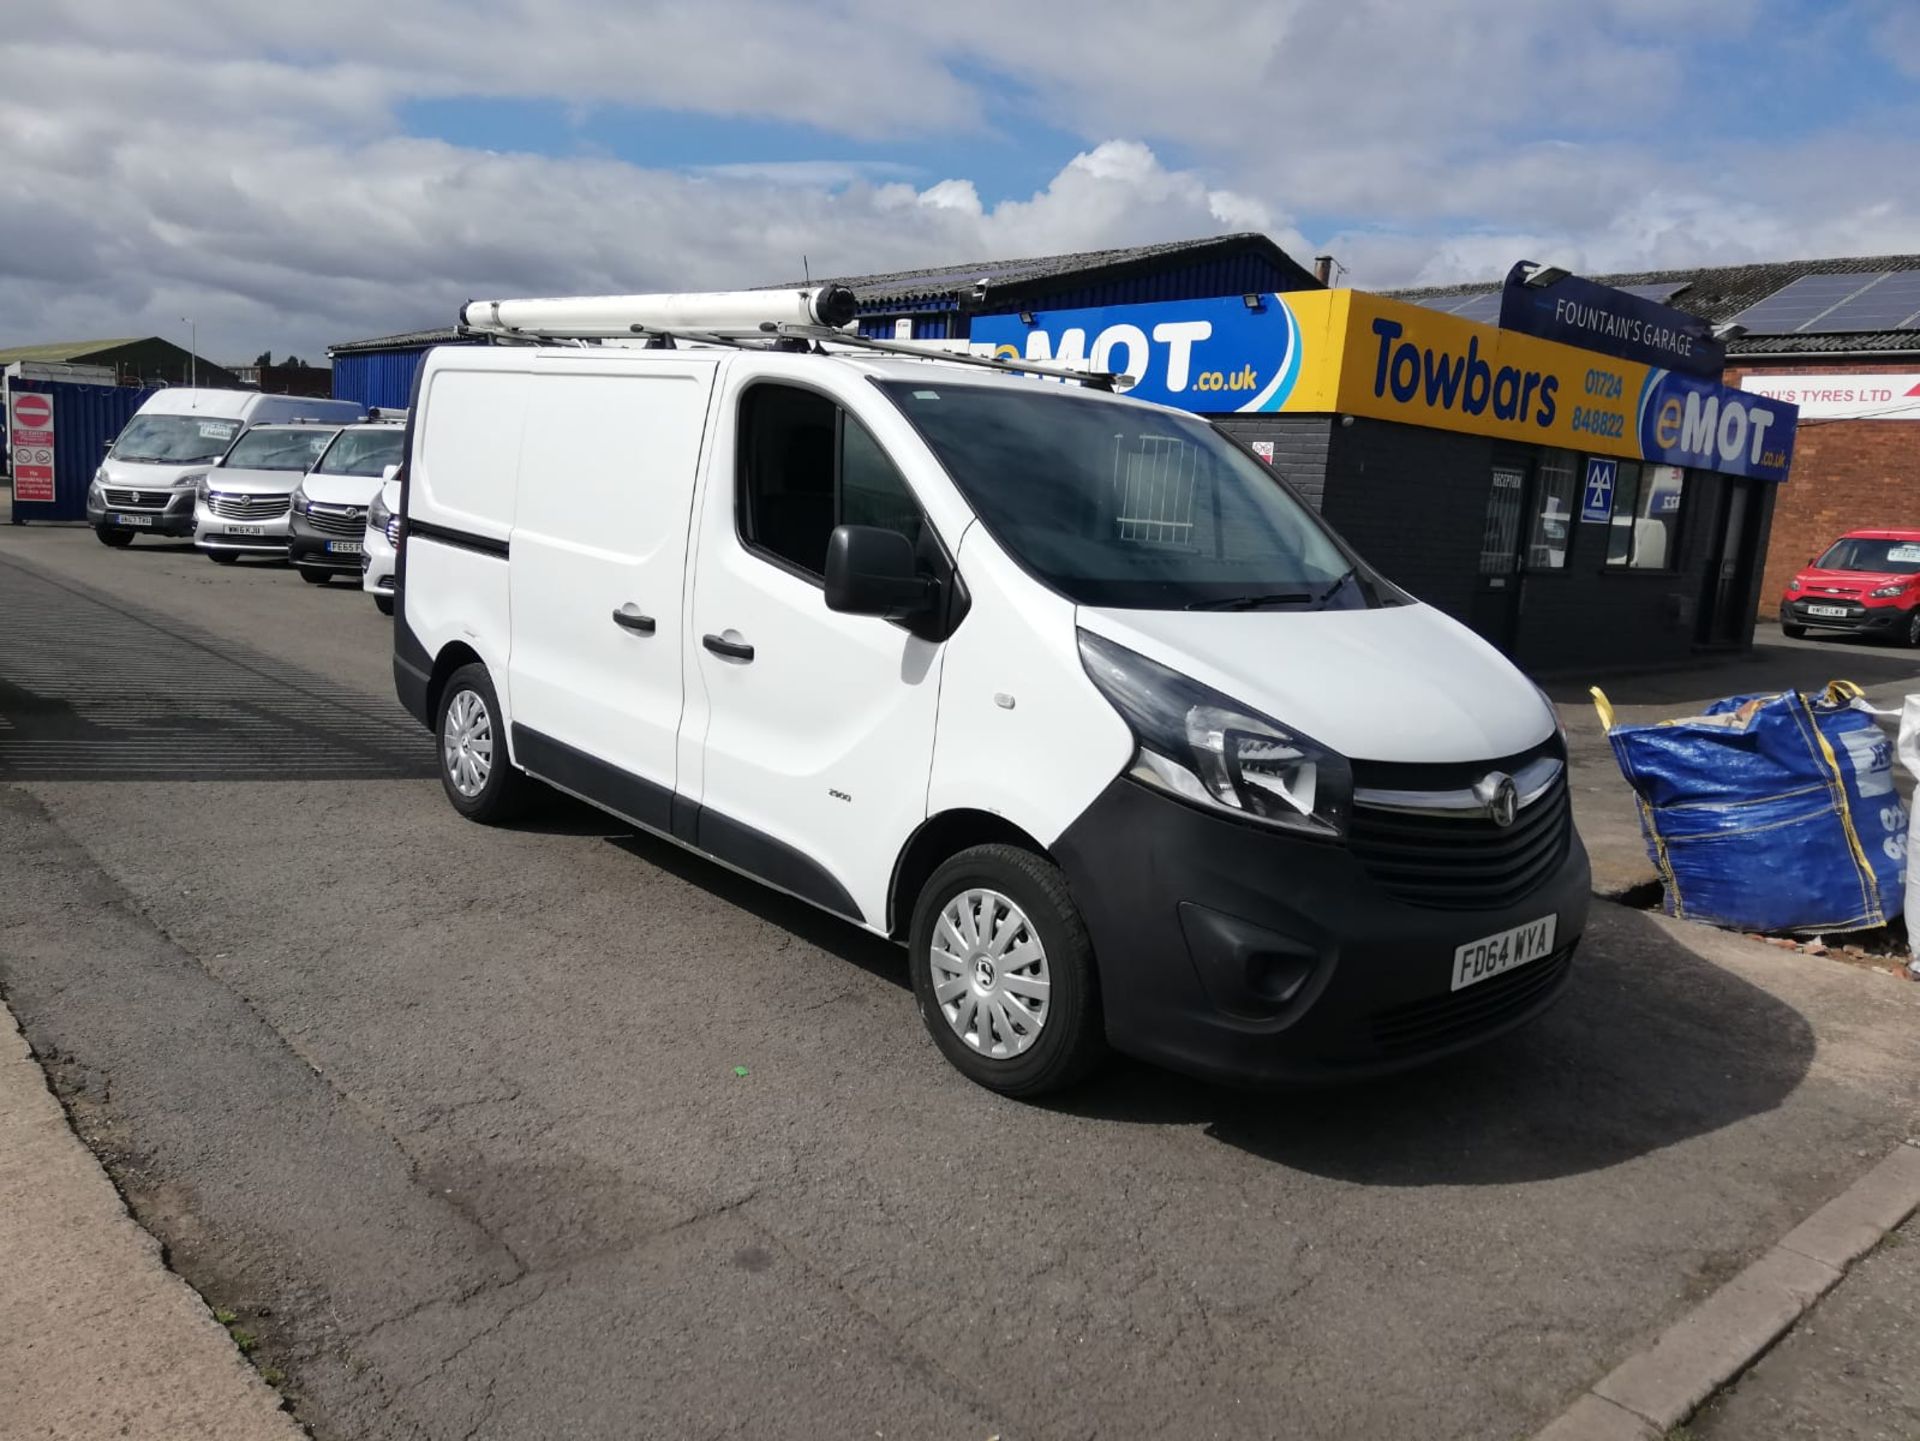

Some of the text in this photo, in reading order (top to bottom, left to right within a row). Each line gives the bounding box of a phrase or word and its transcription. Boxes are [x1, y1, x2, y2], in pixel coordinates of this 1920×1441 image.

[1555, 298, 1693, 357] FOUNTAIN'S GARAGE
[1372, 318, 1560, 427] Towbars
[1584, 368, 1623, 399] 01724
[1798, 390, 1854, 402] TYRES
[1859, 390, 1892, 402] LTD
[1572, 405, 1625, 438] 848822
[1655, 392, 1774, 464] eMOT
[1493, 473, 1522, 489] RECEPTION
[332, 542, 354, 552] FE65
[1459, 923, 1547, 984] FD64 WYA
